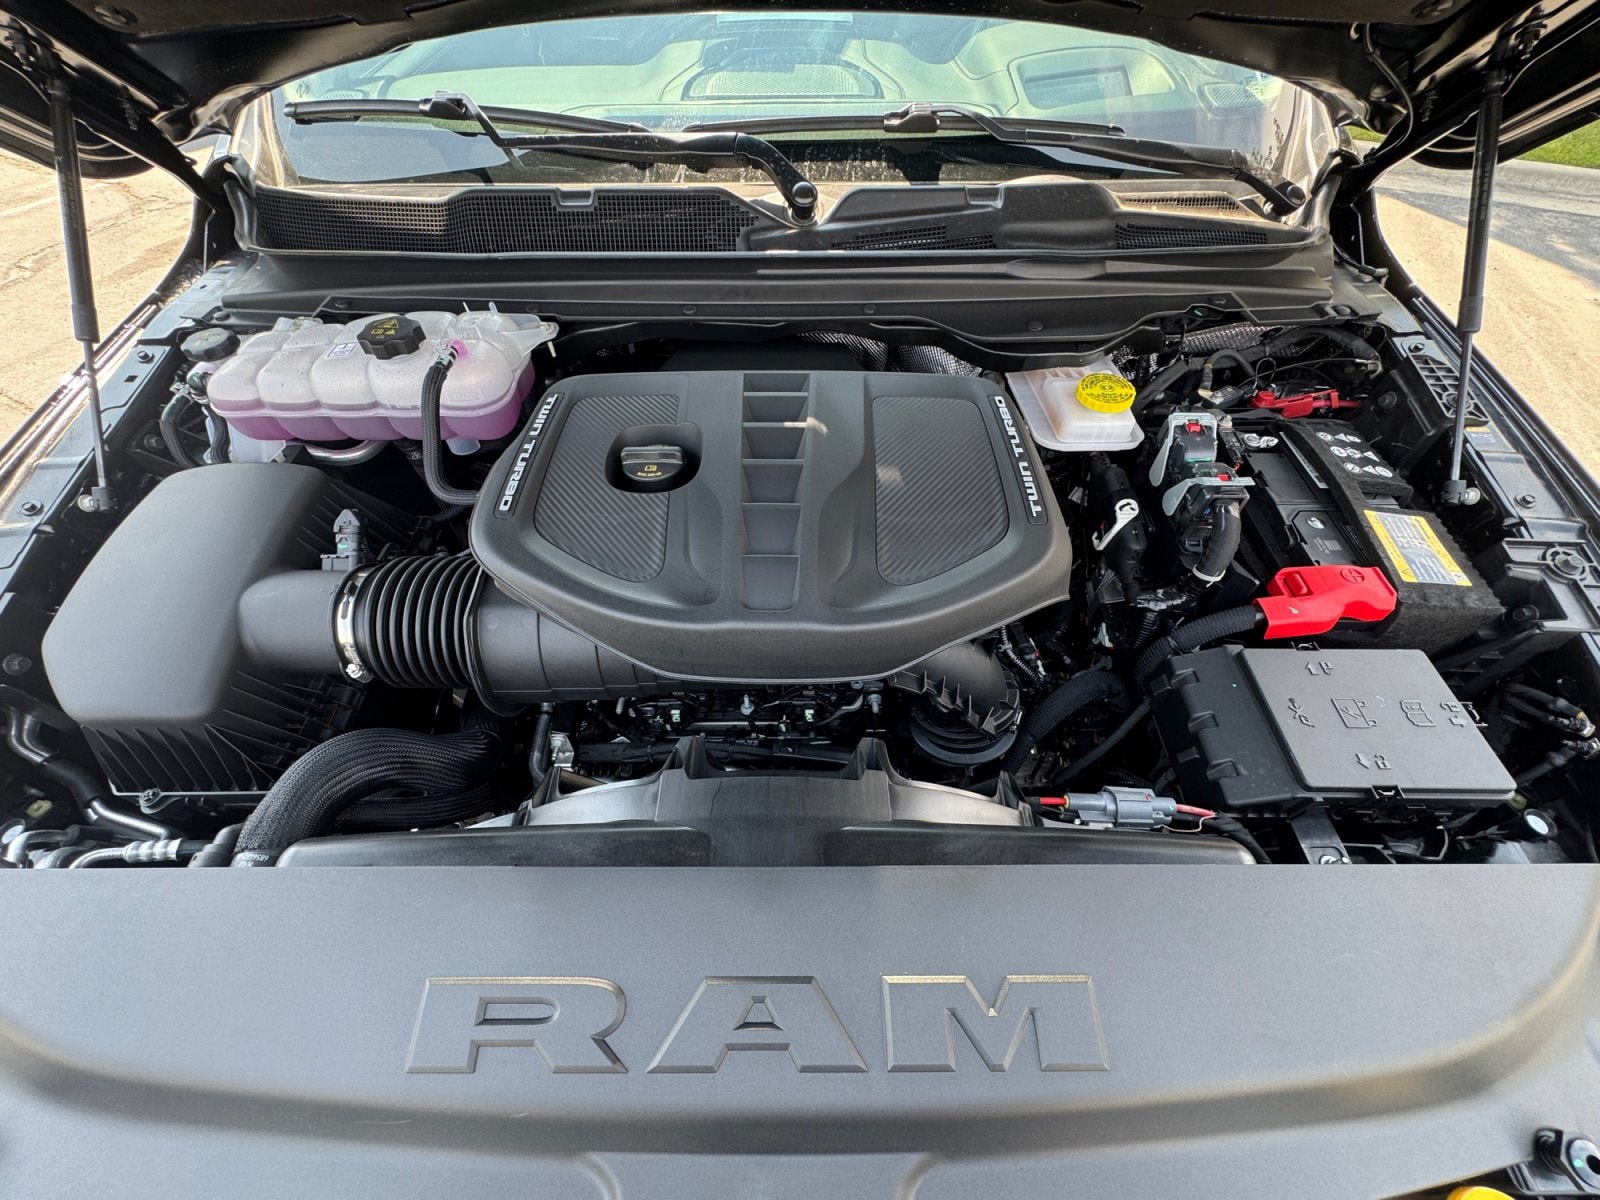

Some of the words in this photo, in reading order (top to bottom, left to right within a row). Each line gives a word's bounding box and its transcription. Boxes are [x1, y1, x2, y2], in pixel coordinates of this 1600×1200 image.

[529, 394, 559, 436] TWIN
[994, 395, 1024, 458] TURBO
[499, 439, 536, 511] TURBO
[1018, 461, 1042, 517] TWIN
[404, 974, 1110, 1074] RAM
